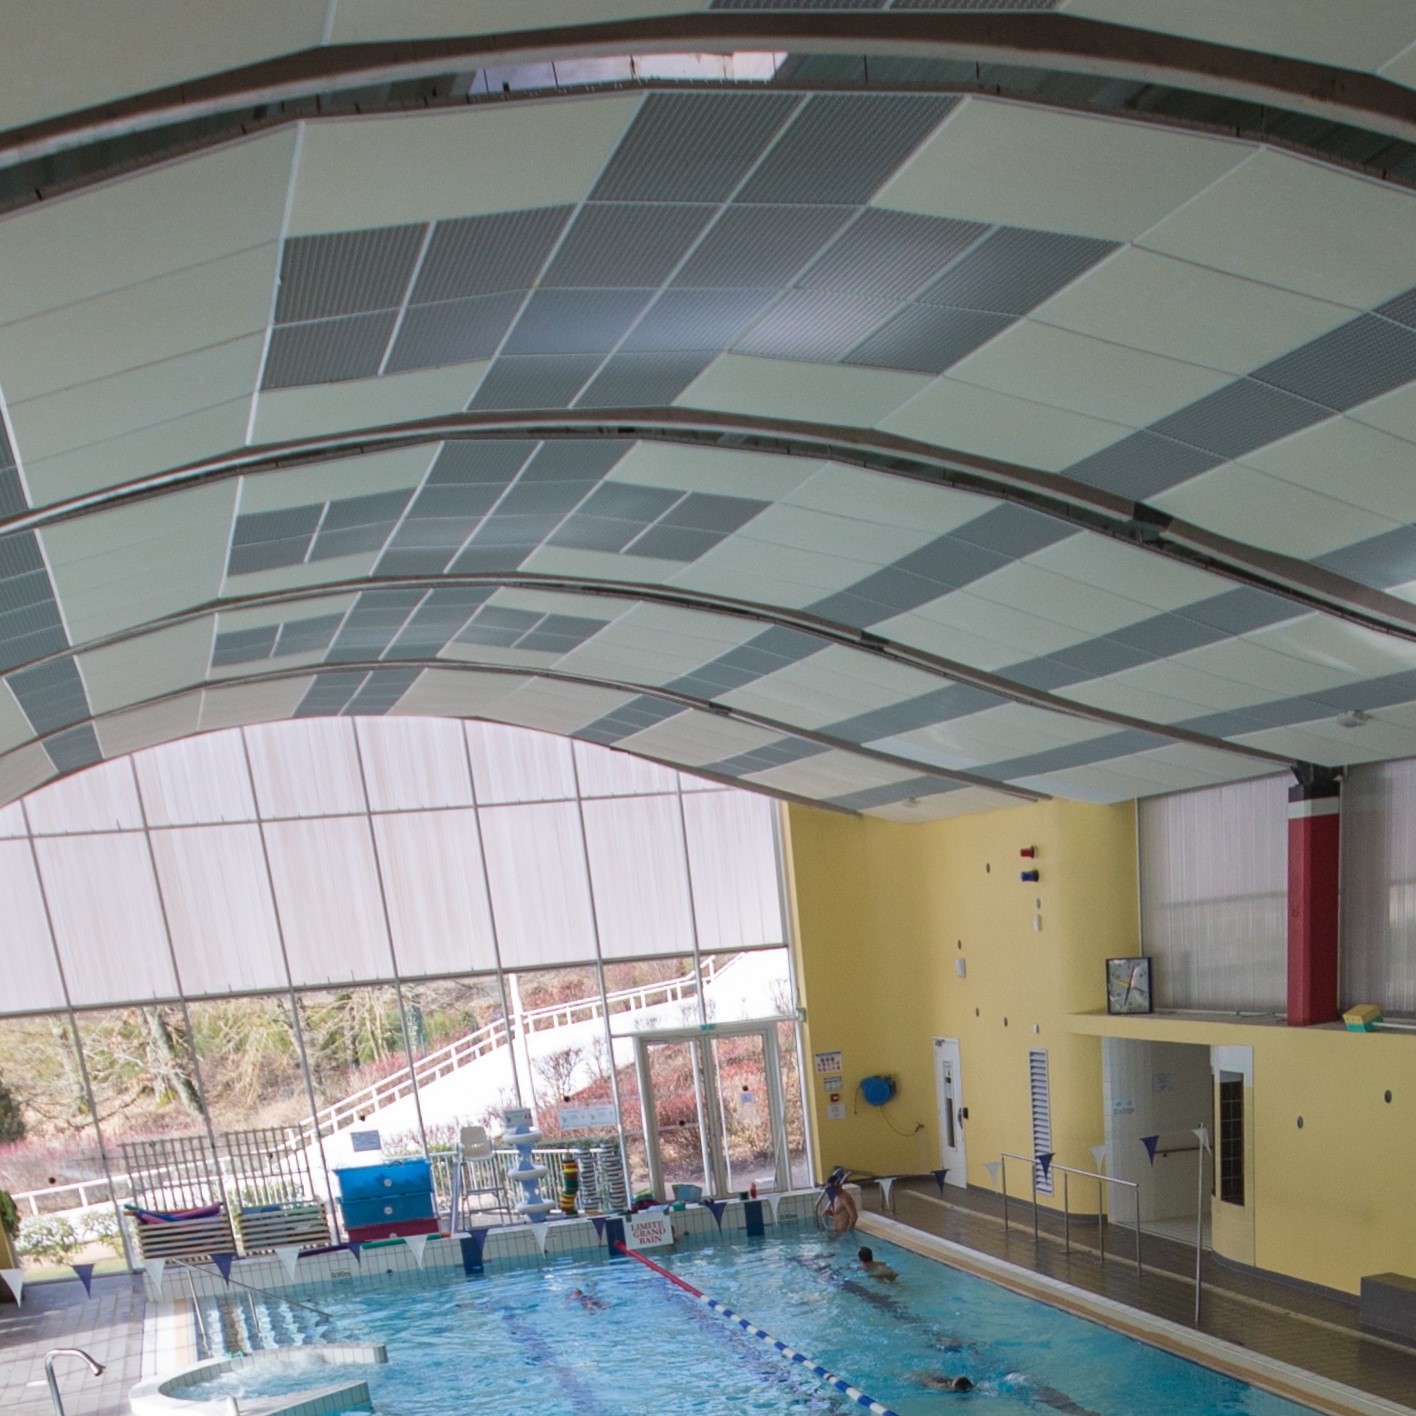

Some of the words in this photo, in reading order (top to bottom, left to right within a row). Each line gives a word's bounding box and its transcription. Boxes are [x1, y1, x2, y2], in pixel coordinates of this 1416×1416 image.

[631, 1220, 664, 1232] LIMITE
[632, 1227, 666, 1238] GRAND
[639, 1235, 662, 1245] BAIN
